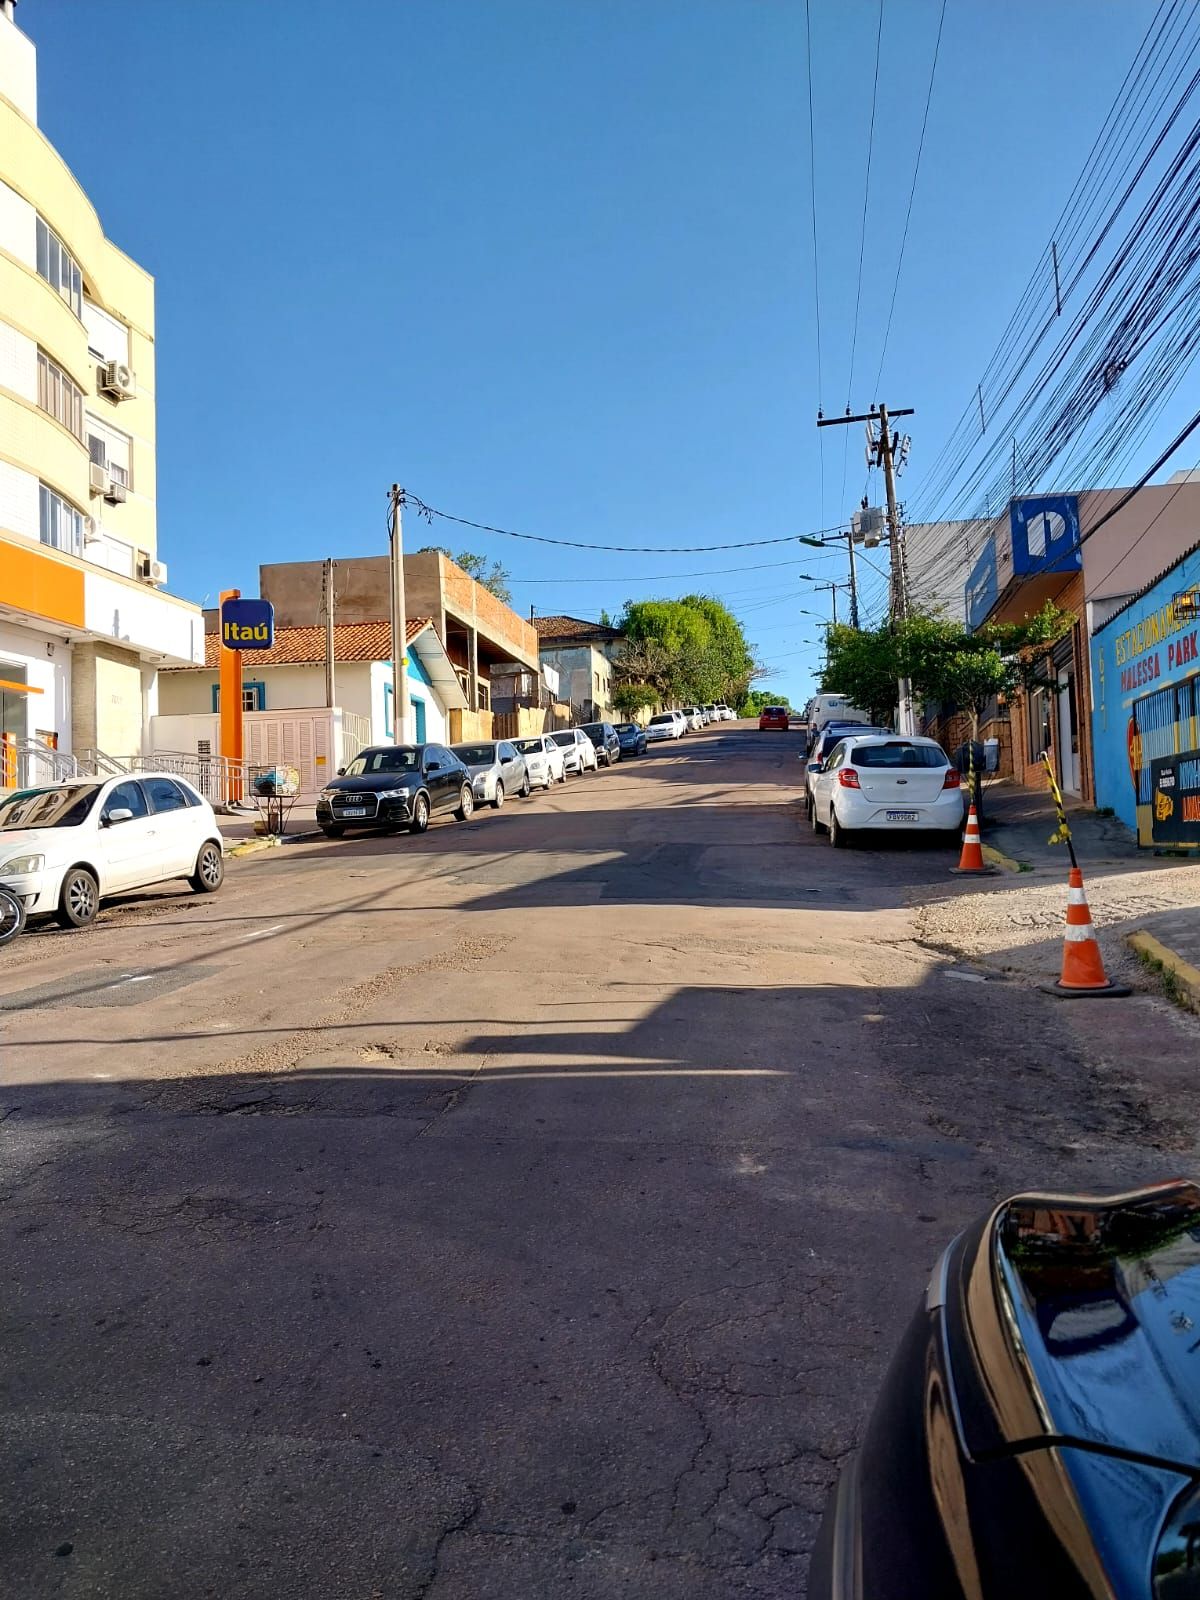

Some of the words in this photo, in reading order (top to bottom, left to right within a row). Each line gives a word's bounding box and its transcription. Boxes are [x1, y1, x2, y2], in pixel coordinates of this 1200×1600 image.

[224, 622, 268, 641] Itaú
[1121, 652, 1160, 694] MALESSA
[1168, 630, 1198, 671] PARK
